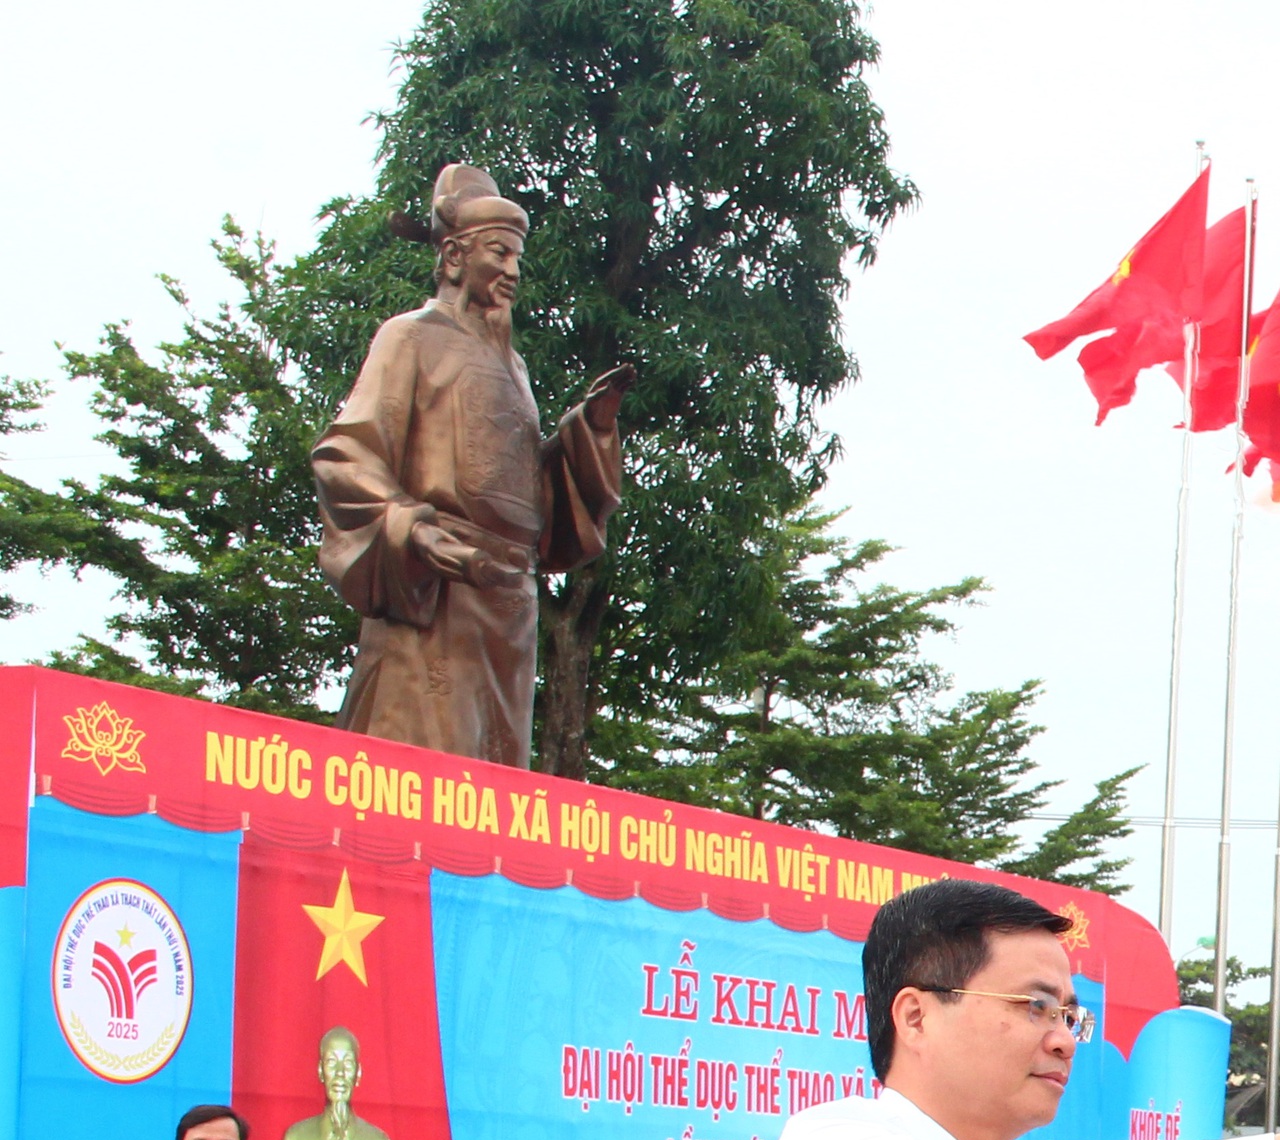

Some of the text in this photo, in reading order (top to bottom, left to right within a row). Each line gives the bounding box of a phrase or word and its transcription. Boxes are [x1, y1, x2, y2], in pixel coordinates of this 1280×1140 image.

[205, 731, 894, 905] NƯỚC CỘNG HÒA XÃ HỘI CHỦ NGHĨA VIỆT NAM
[175, 975, 184, 996] 2025
[641, 940, 699, 1021] LỄ
[711, 974, 821, 1035] KHAI
[107, 1021, 139, 1040] 2025
[563, 1046, 600, 1111] ĐẠI
[607, 1042, 644, 1114] HỘI
[651, 1038, 692, 1107] THỂ
[696, 1060, 738, 1121] DỤC
[745, 1048, 783, 1114] THỂ
[787, 1070, 835, 1115] THAO
